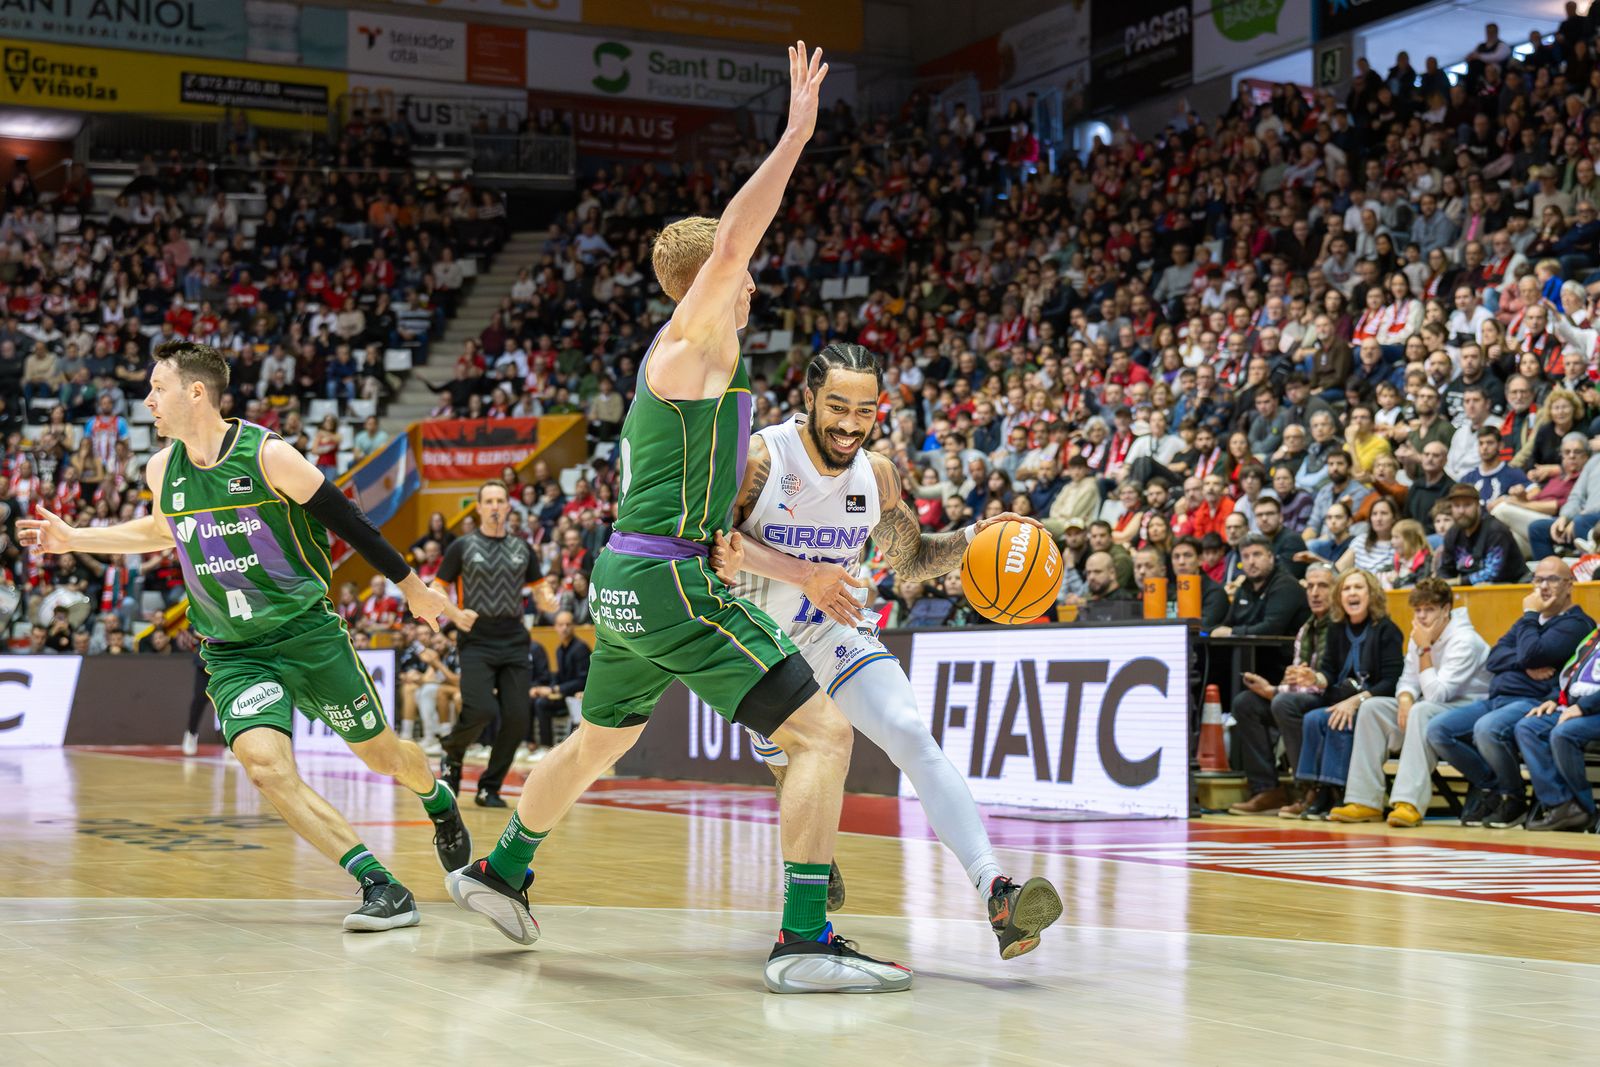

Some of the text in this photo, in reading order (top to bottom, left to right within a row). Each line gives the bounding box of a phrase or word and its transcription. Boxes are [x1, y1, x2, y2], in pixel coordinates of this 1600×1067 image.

[649, 51, 708, 79] Sant
[32, 77, 118, 100] Viñolas
[200, 517, 261, 539] Unicaja
[762, 523, 869, 549] GIRONA
[225, 589, 253, 621] 4
[600, 588, 640, 605] COSTA
[600, 604, 642, 620] DEL SOL
[931, 656, 1170, 788] FIATC
